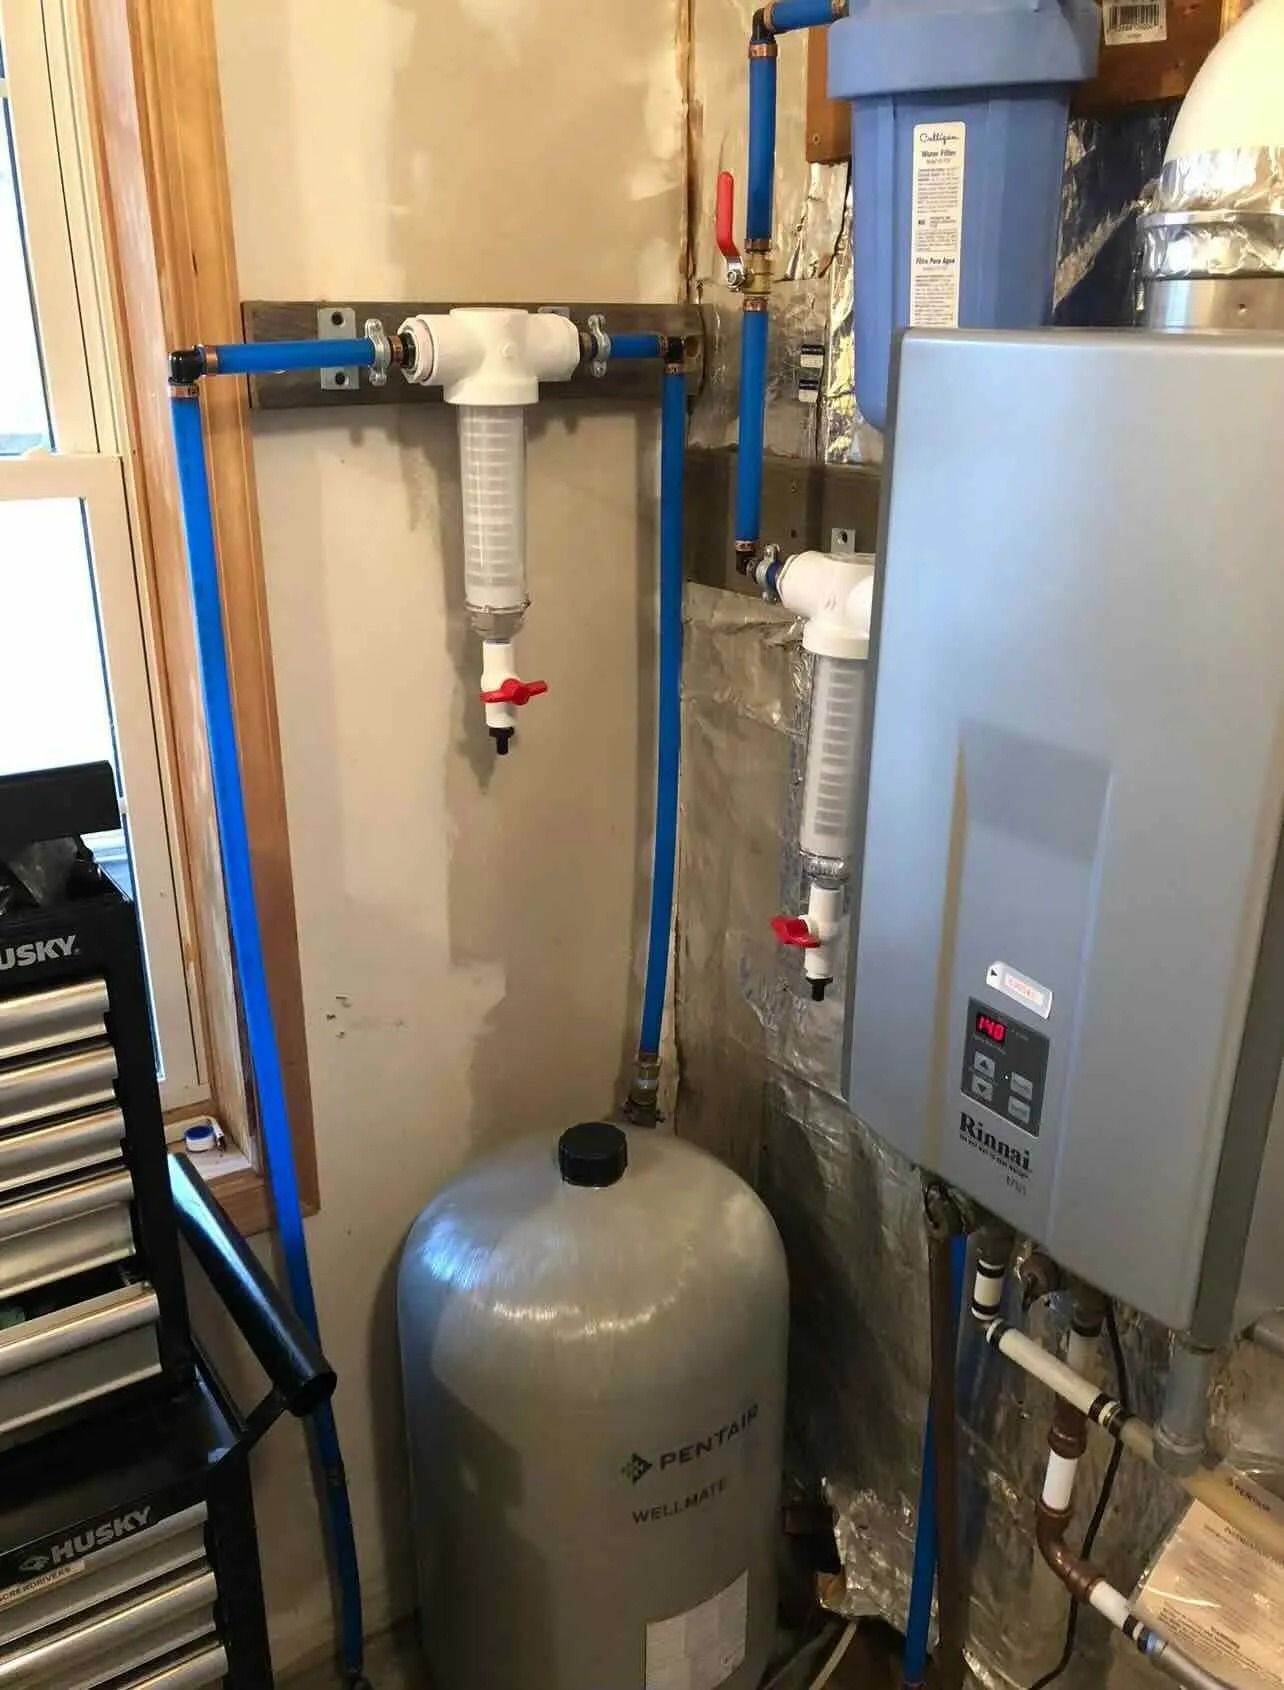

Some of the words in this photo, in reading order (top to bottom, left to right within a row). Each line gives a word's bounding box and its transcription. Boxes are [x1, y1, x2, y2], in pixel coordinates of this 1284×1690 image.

[919, 130, 961, 146] Culligan
[959, 1111, 1031, 1171] Rinnai
[659, 1403, 759, 1471] PENTAIR
[631, 1476, 727, 1525] WELLMATE
[50, 1505, 151, 1565] HUSKY
[0, 1566, 72, 1602] CREWDRIVERS
